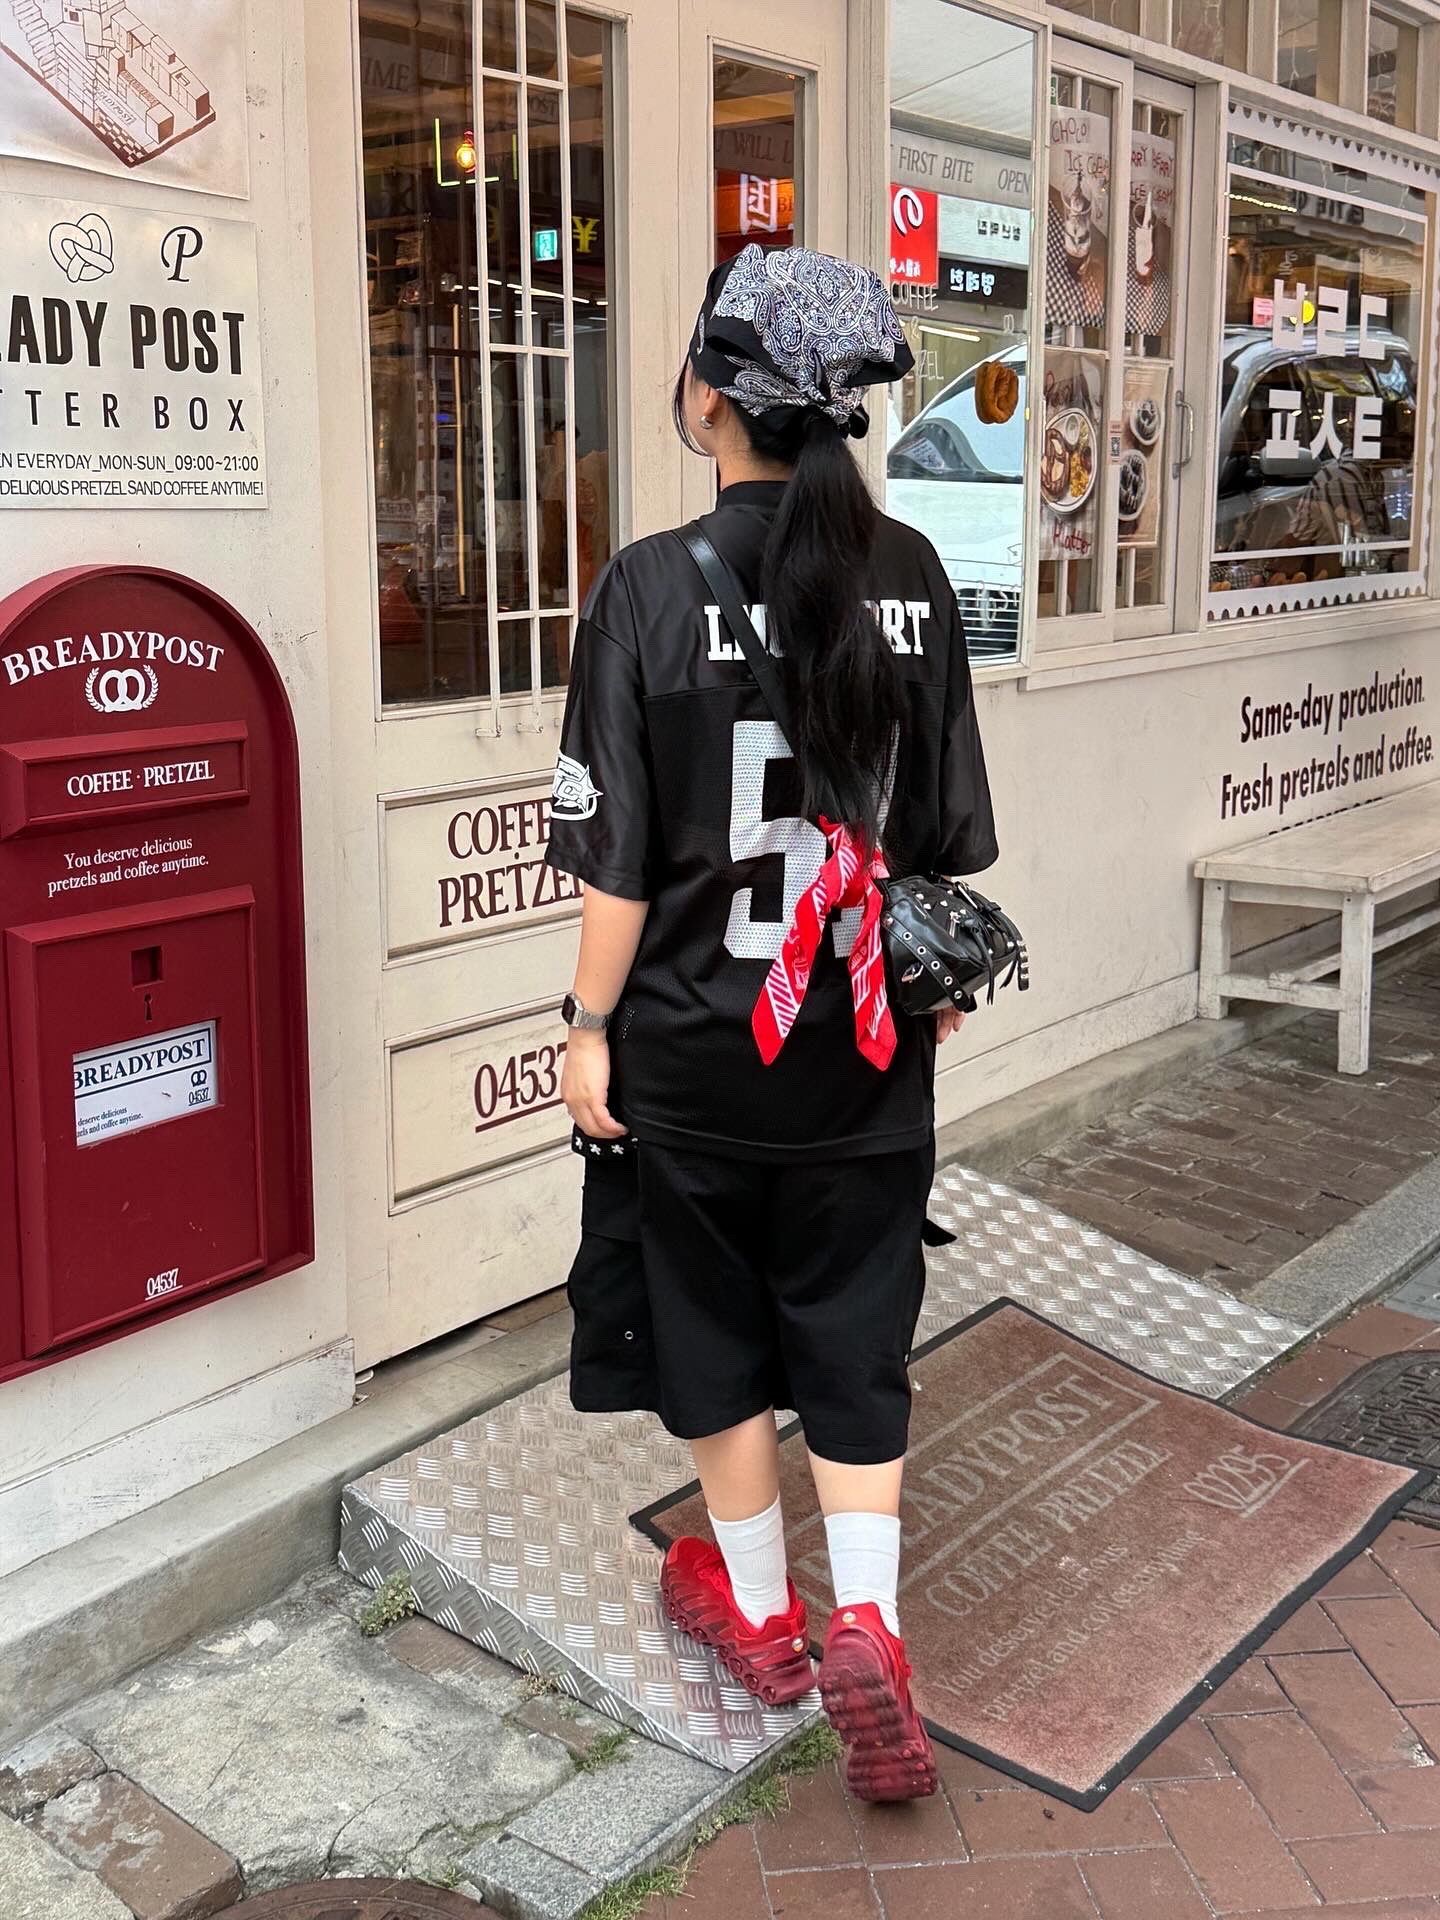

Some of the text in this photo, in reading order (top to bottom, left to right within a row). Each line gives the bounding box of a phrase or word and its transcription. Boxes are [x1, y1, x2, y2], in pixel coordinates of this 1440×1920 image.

[899, 146, 974, 184] FIRST BITE
[998, 168, 1030, 194] OPEN
[890, 280, 939, 312] COFFEE
[0, 294, 245, 376] ADY POST
[0, 388, 246, 433] TER BOX
[0, 479, 69, 496] DELICIOUS
[163, 480, 209, 496] COFFEE
[210, 480, 264, 496] ANYTIME!
[1, 630, 225, 686] BREADYPOST
[1240, 667, 1425, 743] Same-day production.
[67, 759, 215, 798] COFFEE PRETZEL
[1221, 762, 1273, 820] Fresh
[1279, 743, 1350, 815] pretzels
[1353, 733, 1385, 783] and
[1389, 725, 1435, 773] coffee.
[447, 798, 552, 860] COFFE
[64, 837, 193, 870] You deserve delicious
[48, 852, 209, 898] pretzels and coffee anytime.
[74, 1037, 206, 1090] BREADYPOST
[78, 1106, 128, 1126] deserve delicious
[89, 1123, 101, 1135] and
[101, 1118, 119, 1130] coffee
[145, 1266, 180, 1299] 04537
[1034, 1438, 1174, 1533] PRETZEL
